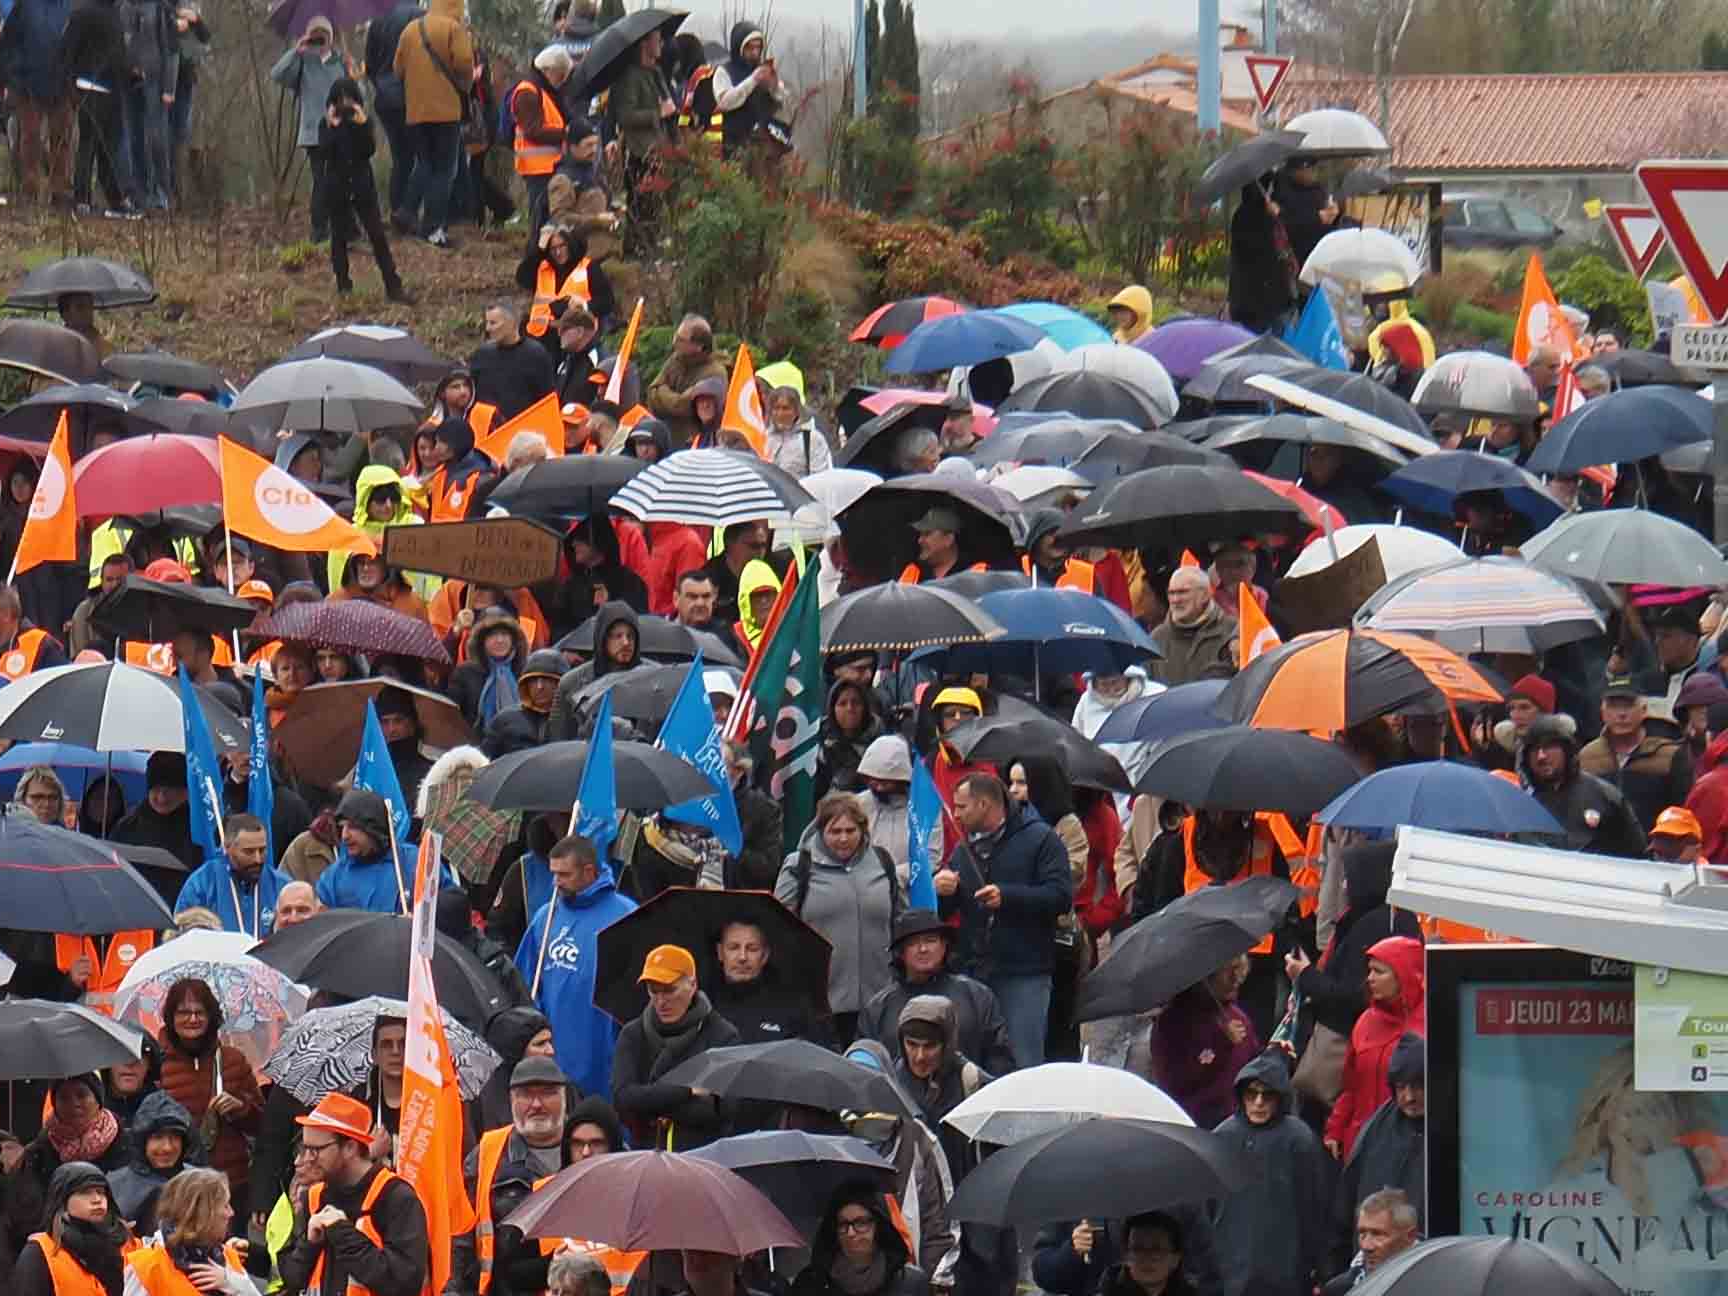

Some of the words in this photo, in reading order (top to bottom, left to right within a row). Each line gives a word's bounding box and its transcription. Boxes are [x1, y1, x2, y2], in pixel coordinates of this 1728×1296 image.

[1504, 999, 1561, 1025] JEUDI
[1566, 999, 1592, 1023] 23
[1477, 1191, 1604, 1208] CAROLINE
